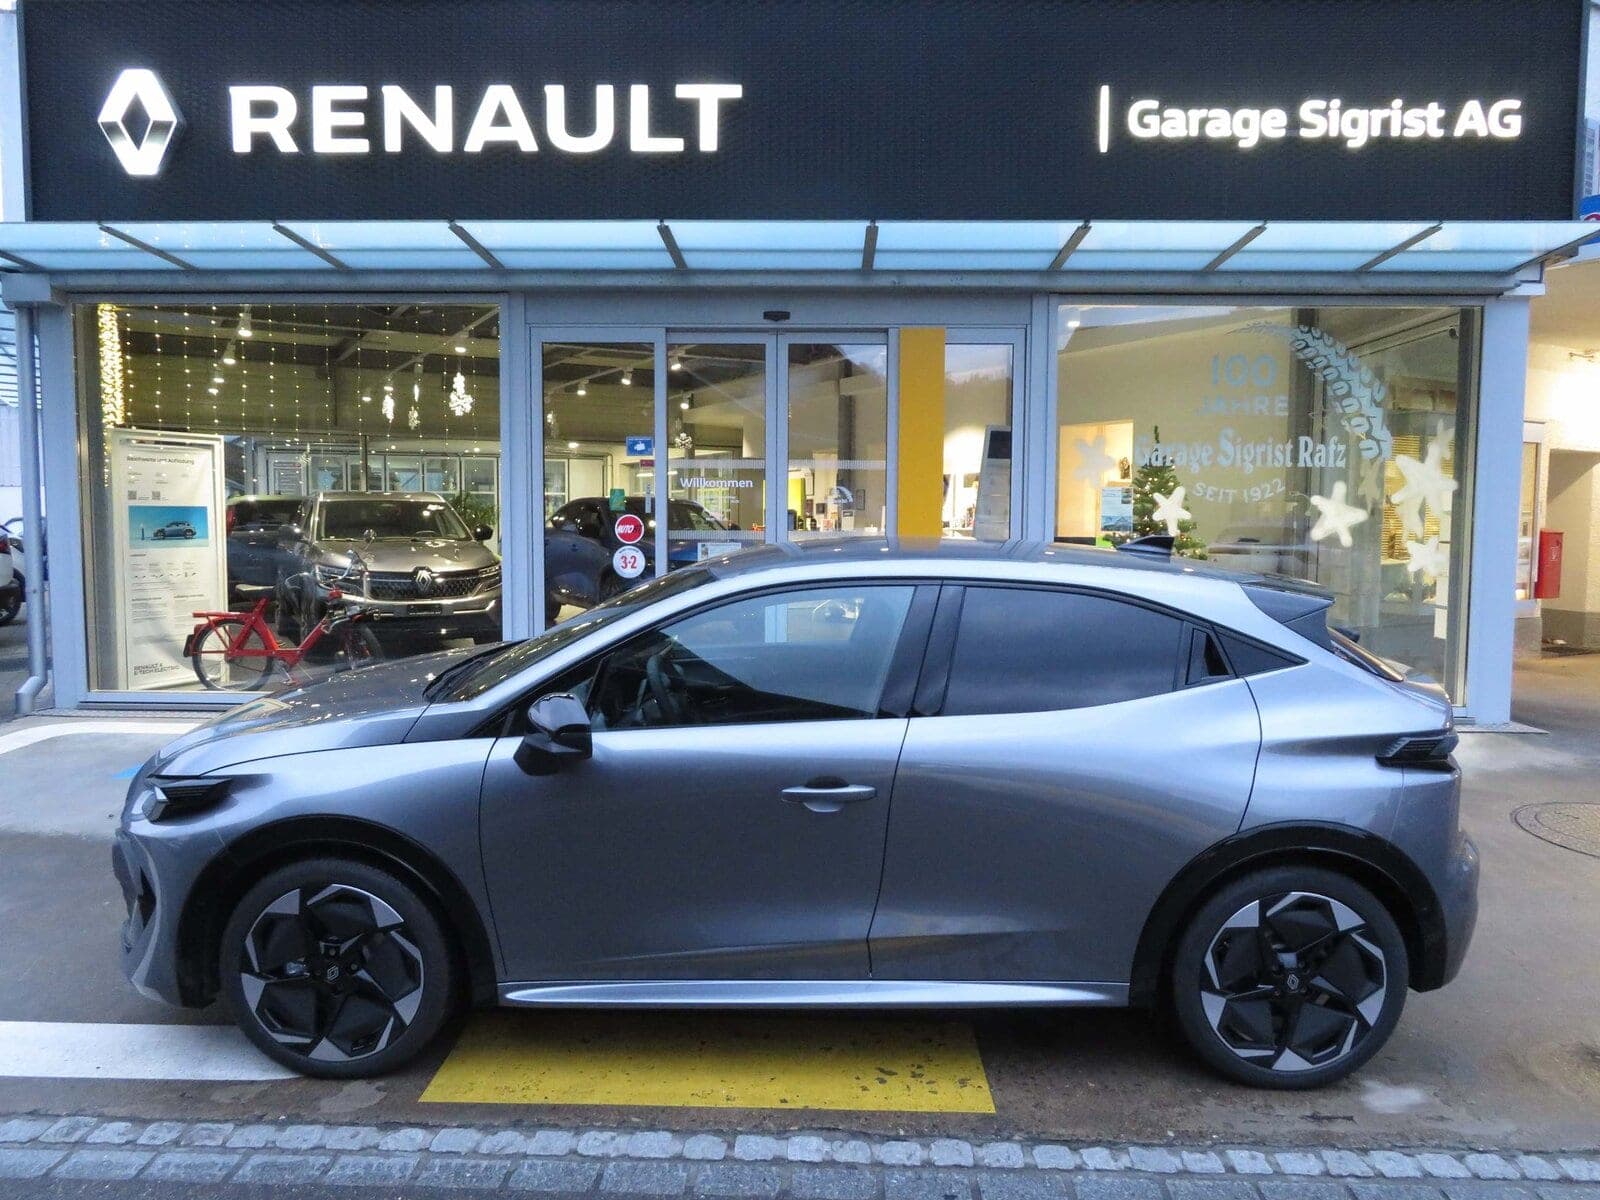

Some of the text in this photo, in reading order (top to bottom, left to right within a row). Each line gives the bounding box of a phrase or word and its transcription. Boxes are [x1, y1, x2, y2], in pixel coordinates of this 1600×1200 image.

[229, 83, 743, 154] RENAULT
[1127, 98, 1524, 150] Garage Sigrist AG
[1210, 353, 1278, 388] 100
[1196, 395, 1289, 416] JAHRE
[1134, 426, 1346, 476] Garage Sigrist Rafz
[679, 477, 754, 489] Willkommen
[1192, 477, 1286, 504] SEIT 1922
